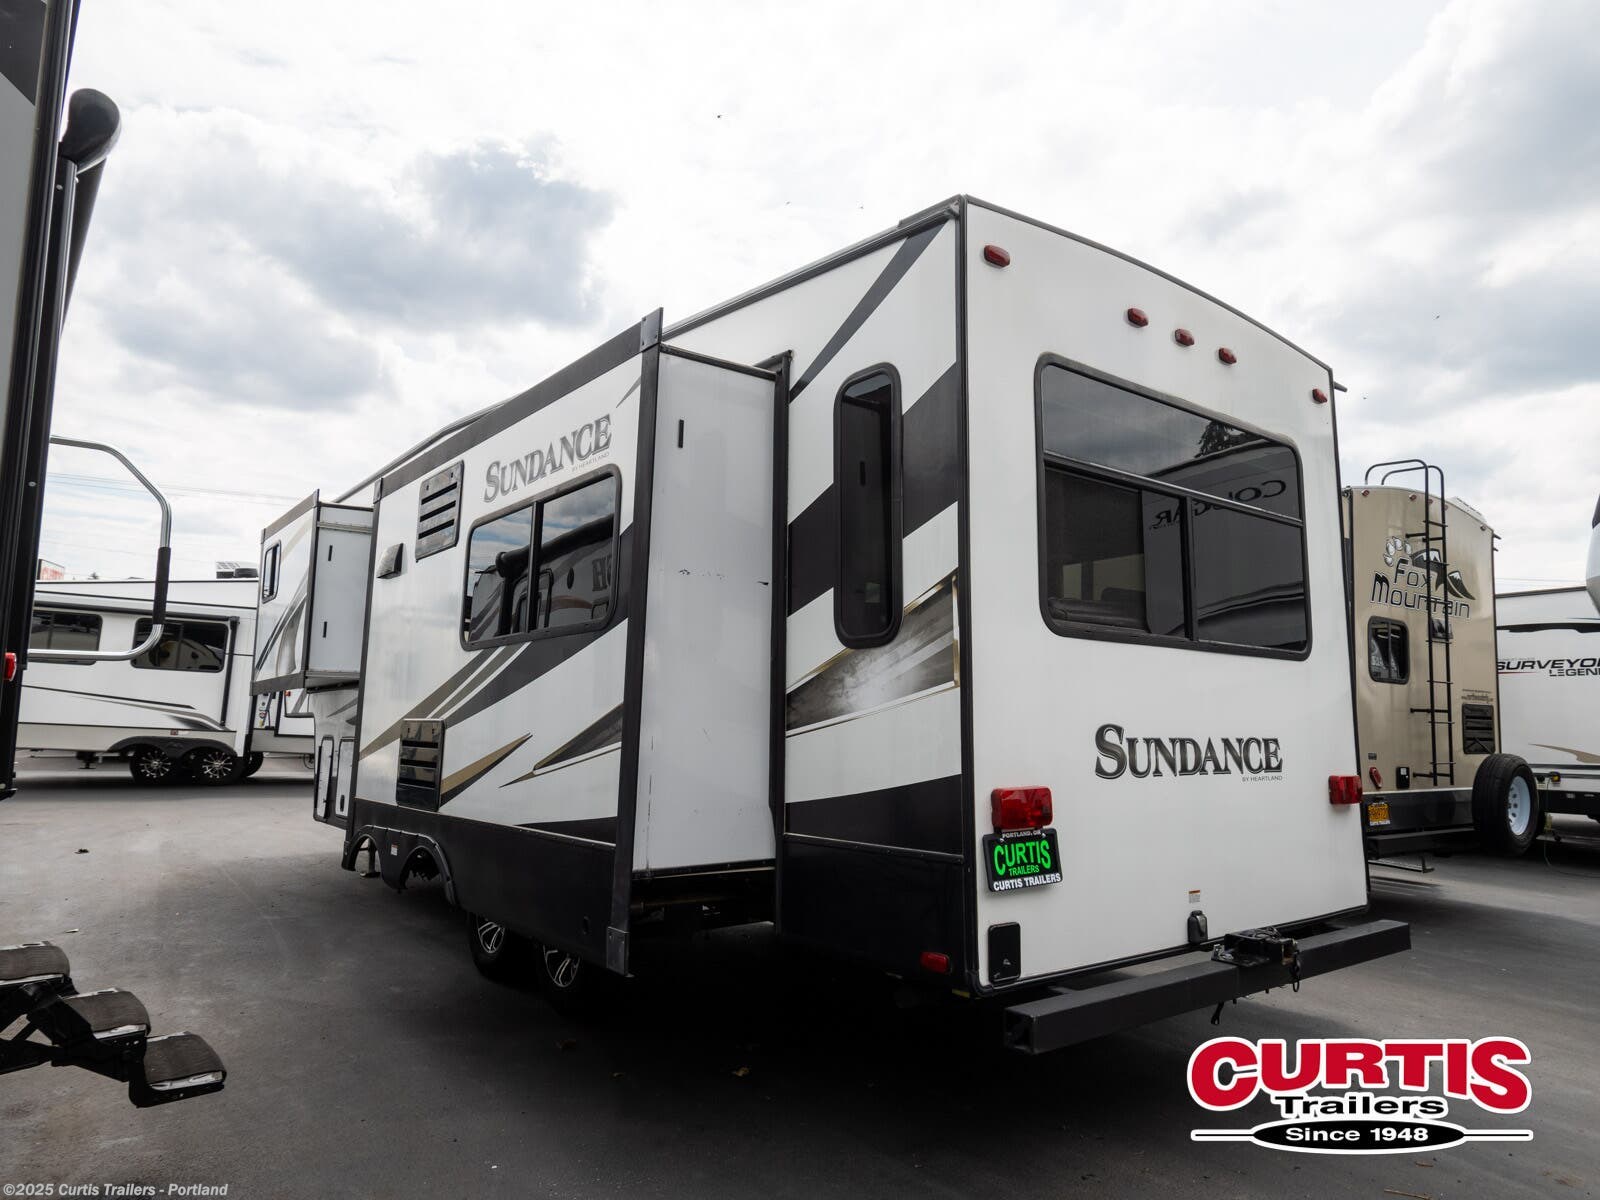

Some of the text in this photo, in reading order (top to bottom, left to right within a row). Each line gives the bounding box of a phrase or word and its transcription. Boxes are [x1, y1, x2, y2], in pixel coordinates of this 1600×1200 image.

[483, 413, 612, 503] SUNDANCE
[1549, 668, 1600, 677] LEGEN
[1095, 723, 1283, 780] SUNDANCE
[994, 840, 1051, 875] CURTIS
[1009, 865, 1040, 876] TRAILERS
[993, 873, 1061, 891] CURTIS TRAILERS
